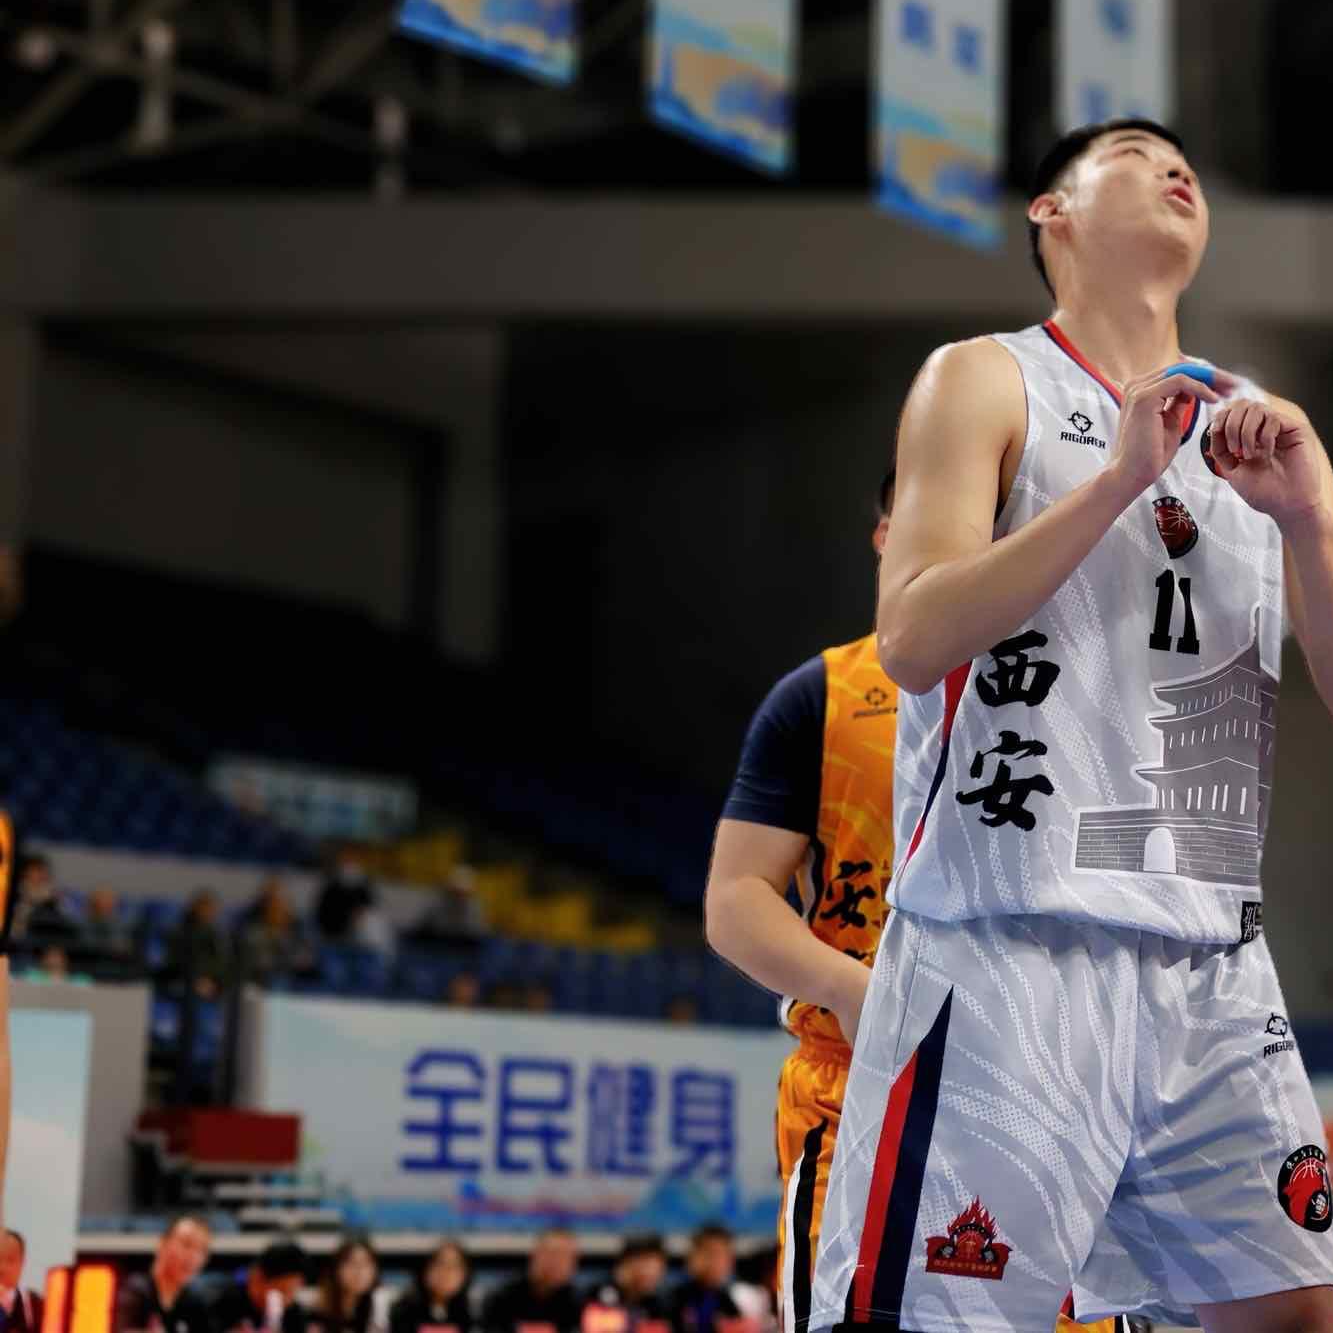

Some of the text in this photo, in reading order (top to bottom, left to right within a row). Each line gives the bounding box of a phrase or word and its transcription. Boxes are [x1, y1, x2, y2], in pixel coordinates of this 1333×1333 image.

[1060, 430, 1107, 450] RIGORER
[1148, 568, 1201, 656] 11
[955, 629, 1062, 833] 西安
[400, 1047, 739, 1181] 全民健身
